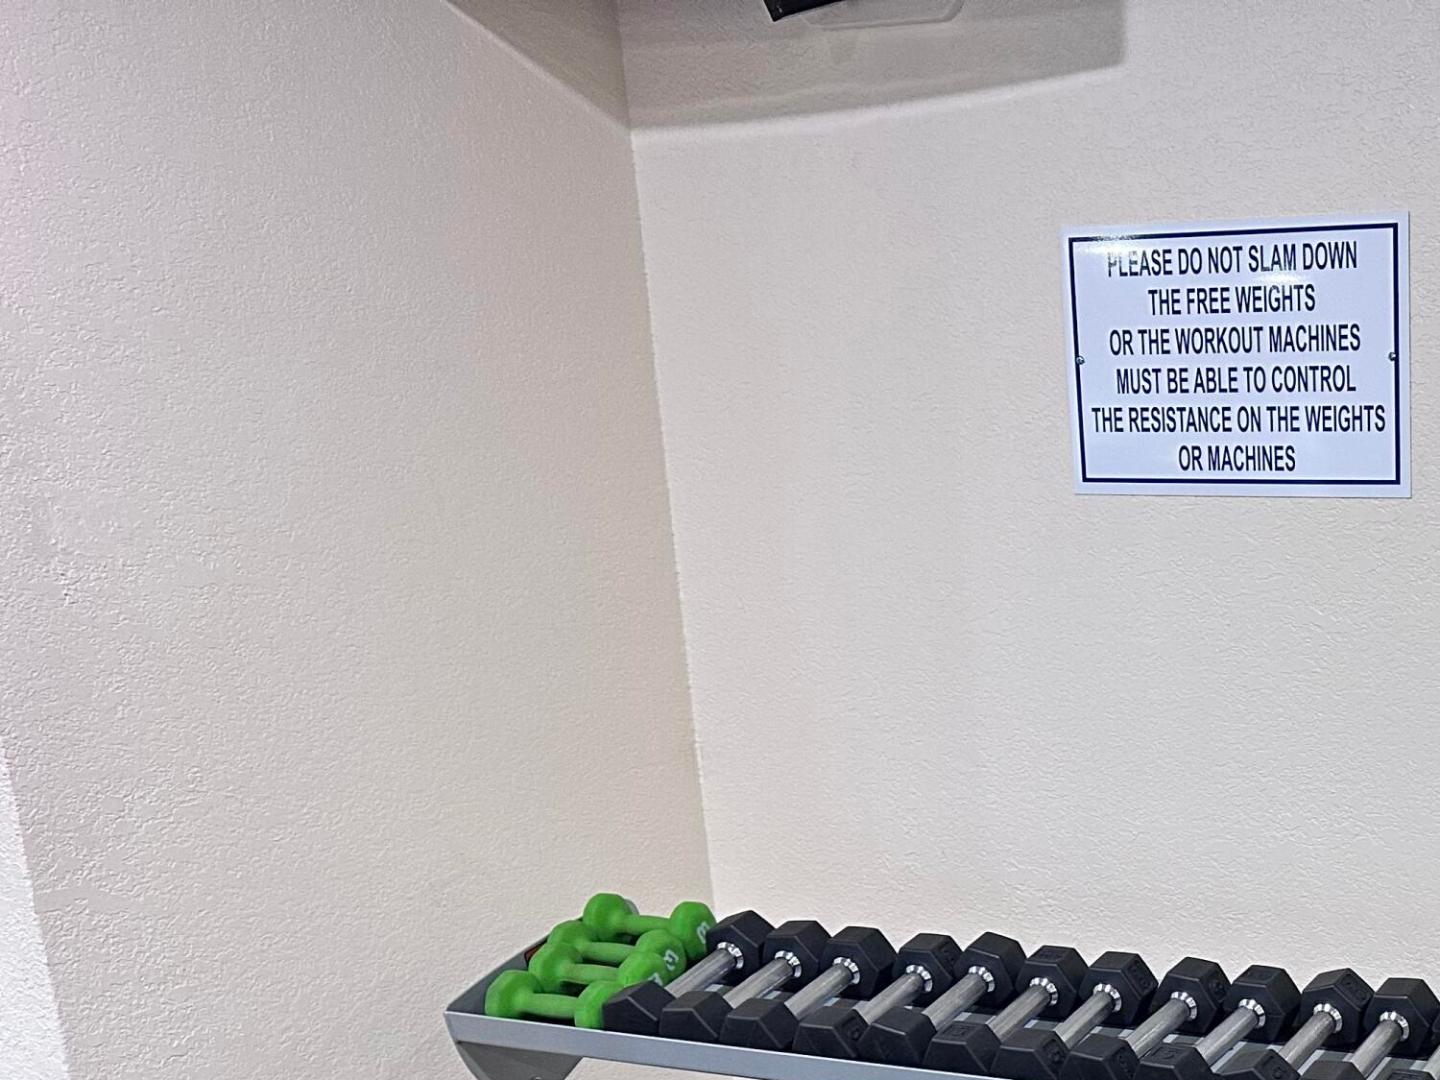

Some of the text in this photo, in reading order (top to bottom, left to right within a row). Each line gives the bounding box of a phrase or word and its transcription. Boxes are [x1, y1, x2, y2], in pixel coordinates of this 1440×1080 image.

[1107, 241, 1358, 278] PLEASE DO NOT SLAM DOWN
[1148, 283, 1316, 316] THE FREE WEIGHTS
[1109, 323, 1361, 356] OR THE WORKOUT MACHINES
[1116, 364, 1357, 394] MUST BE ABLE TO CONTROL
[1091, 404, 1386, 433] THE RESISTANCE ON THE WEIGHTS
[1178, 445, 1296, 472] OR MACHINES
